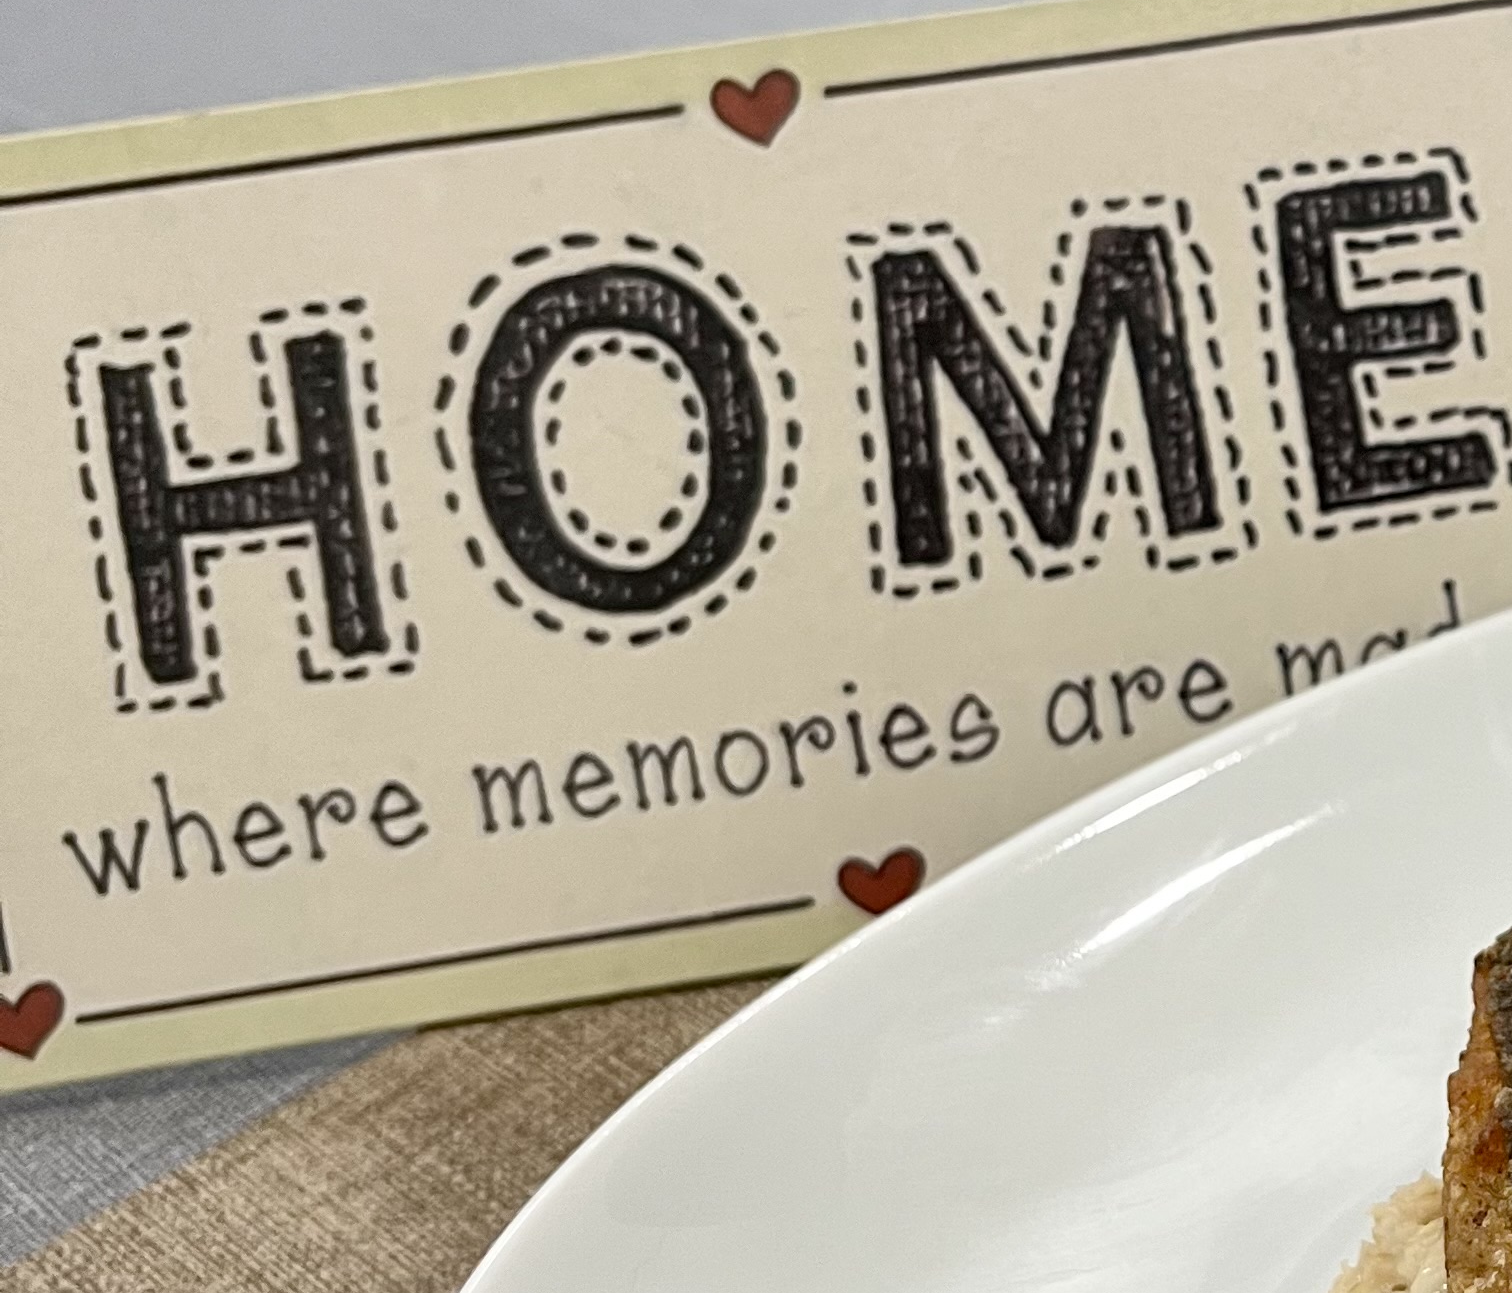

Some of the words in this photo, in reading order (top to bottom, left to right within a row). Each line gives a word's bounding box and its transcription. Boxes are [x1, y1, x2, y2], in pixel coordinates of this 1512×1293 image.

[62, 773, 429, 897] where
[472, 680, 1002, 834] memories
[1046, 657, 1232, 747] are
